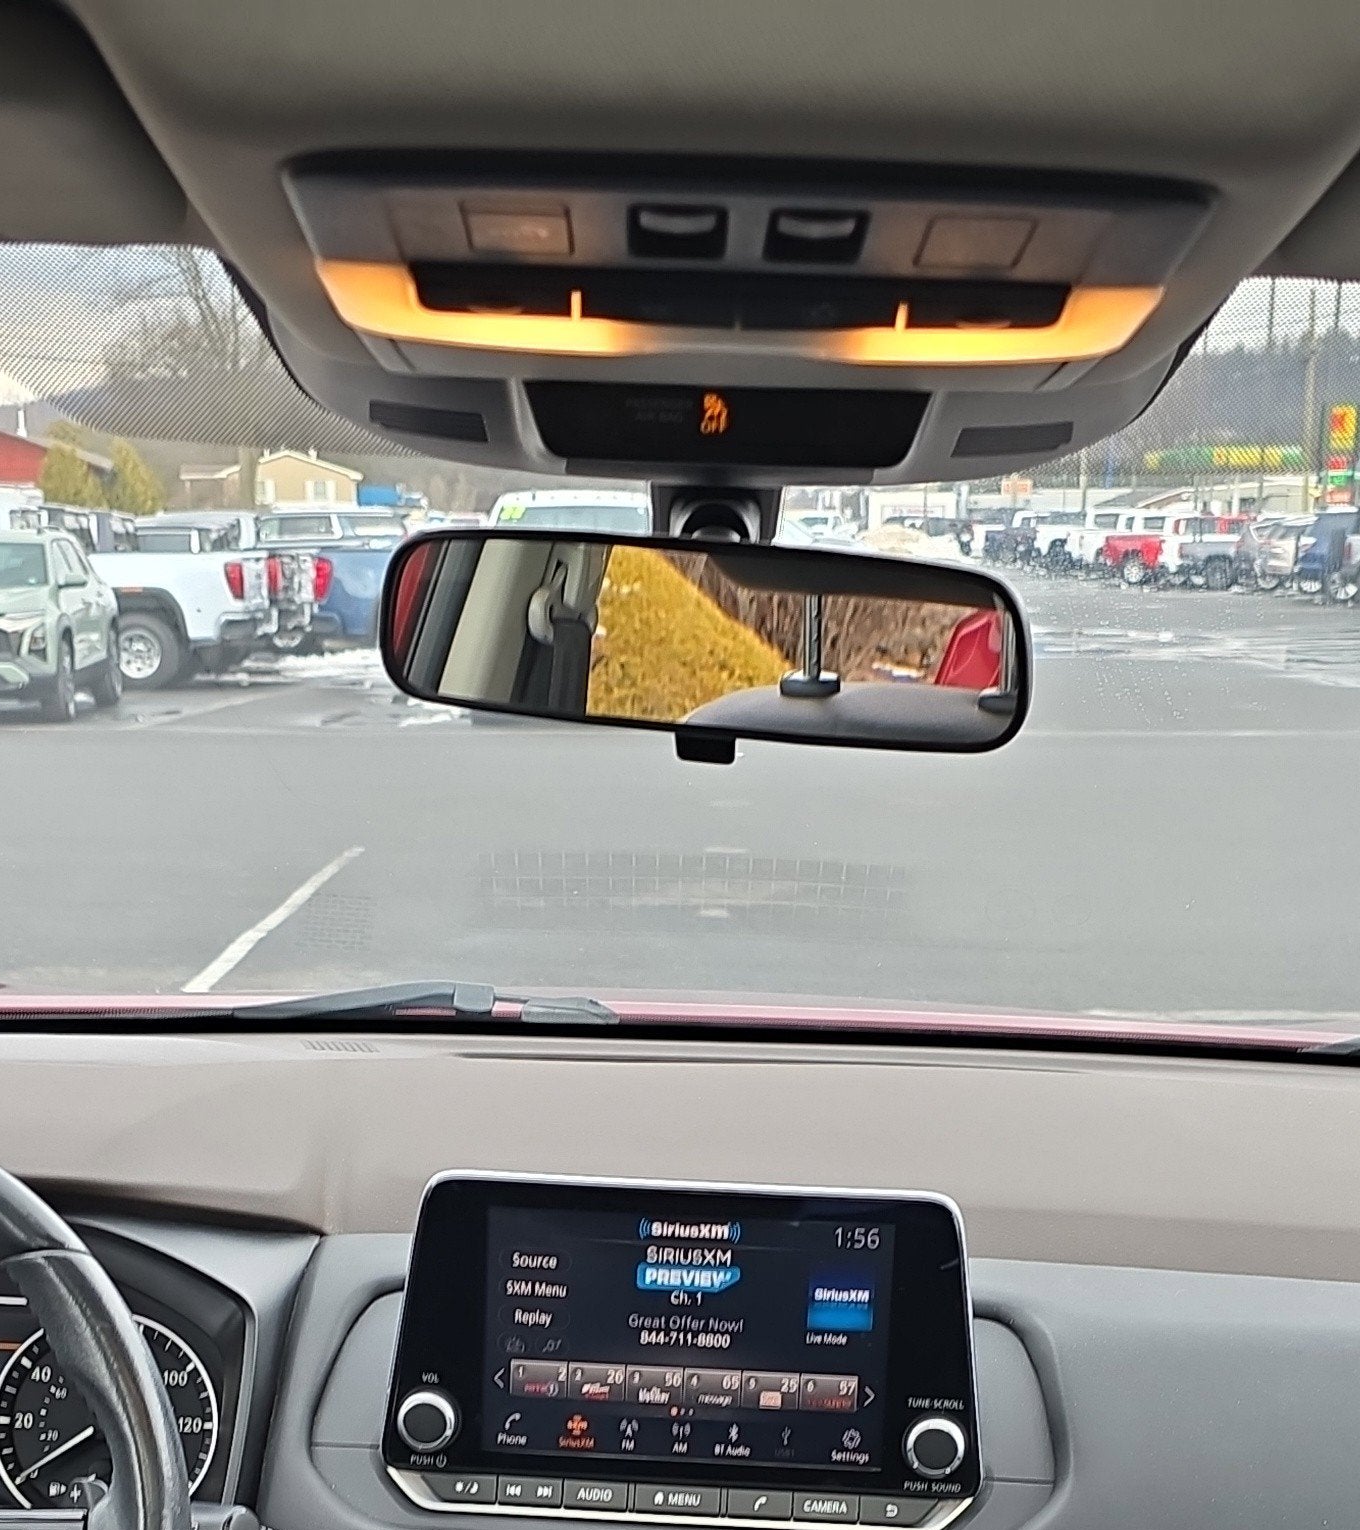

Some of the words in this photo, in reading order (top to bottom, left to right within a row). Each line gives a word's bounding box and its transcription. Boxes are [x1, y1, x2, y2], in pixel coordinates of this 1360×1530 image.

[651, 1221, 730, 1241] SiriusXM
[834, 1227, 881, 1250] 1:56
[512, 1252, 558, 1269] Source
[646, 1245, 732, 1266] SIRIUSXM
[645, 1268, 731, 1286] PREVIEW
[506, 1281, 531, 1297] SXM
[535, 1281, 568, 1298] Menu
[697, 1291, 704, 1306] 1
[514, 1308, 553, 1329] Replay
[628, 1313, 665, 1328] Great
[669, 1315, 704, 1331] Offer
[31, 1366, 51, 1383] 40
[163, 1370, 189, 1387] 100
[421, 1371, 440, 1384] VOL
[14, 1412, 34, 1430] 20
[178, 1417, 203, 1434] 120
[496, 1432, 528, 1447] Phone
[672, 1442, 688, 1455] AM
[831, 1449, 870, 1464] Settings
[409, 1453, 435, 1466] PUSH
[577, 1487, 613, 1502] AUDIO
[903, 1480, 929, 1492] PUSH
[931, 1482, 962, 1493] SOUND
[667, 1491, 702, 1507] MENU
[802, 1499, 848, 1514] CAMERA
